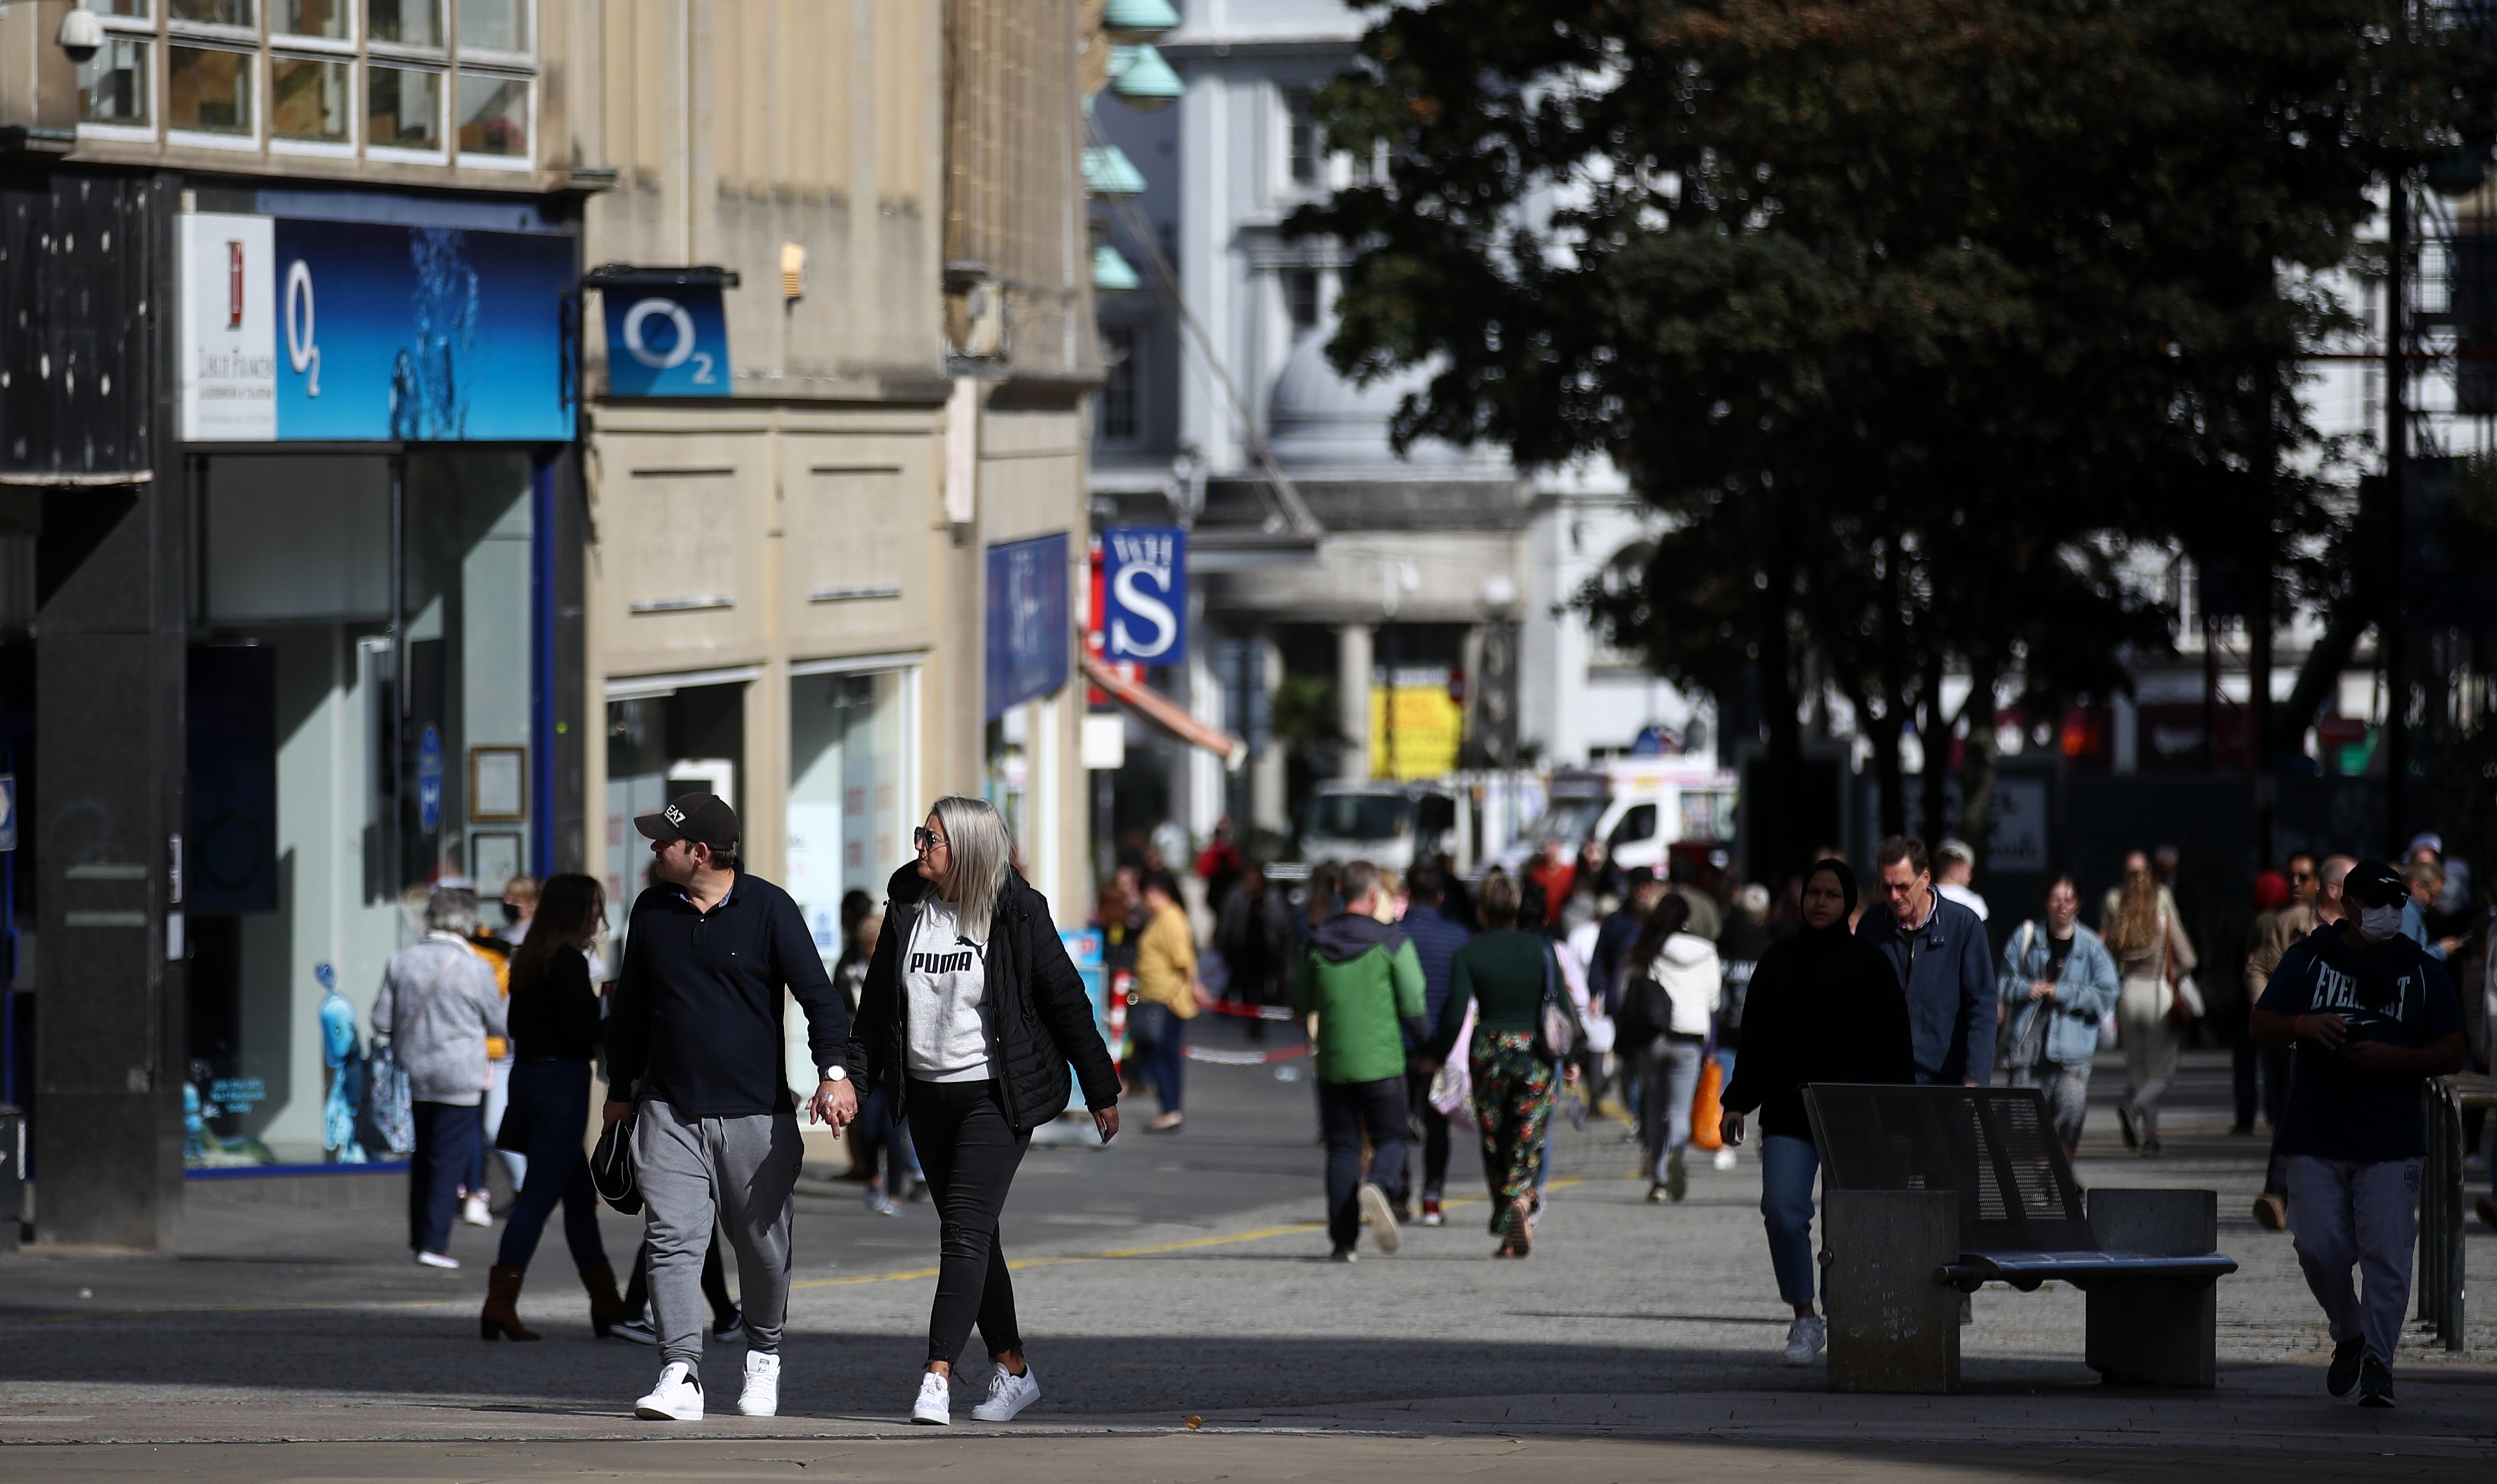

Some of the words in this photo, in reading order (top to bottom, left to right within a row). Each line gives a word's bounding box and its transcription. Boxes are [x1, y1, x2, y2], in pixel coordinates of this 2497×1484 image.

[286, 259, 321, 397] O2
[624, 298, 715, 384] O2
[1113, 533, 1173, 563] WH
[1112, 562, 1177, 657] S
[666, 804, 686, 823] EA7
[910, 952, 973, 974] PUMA
